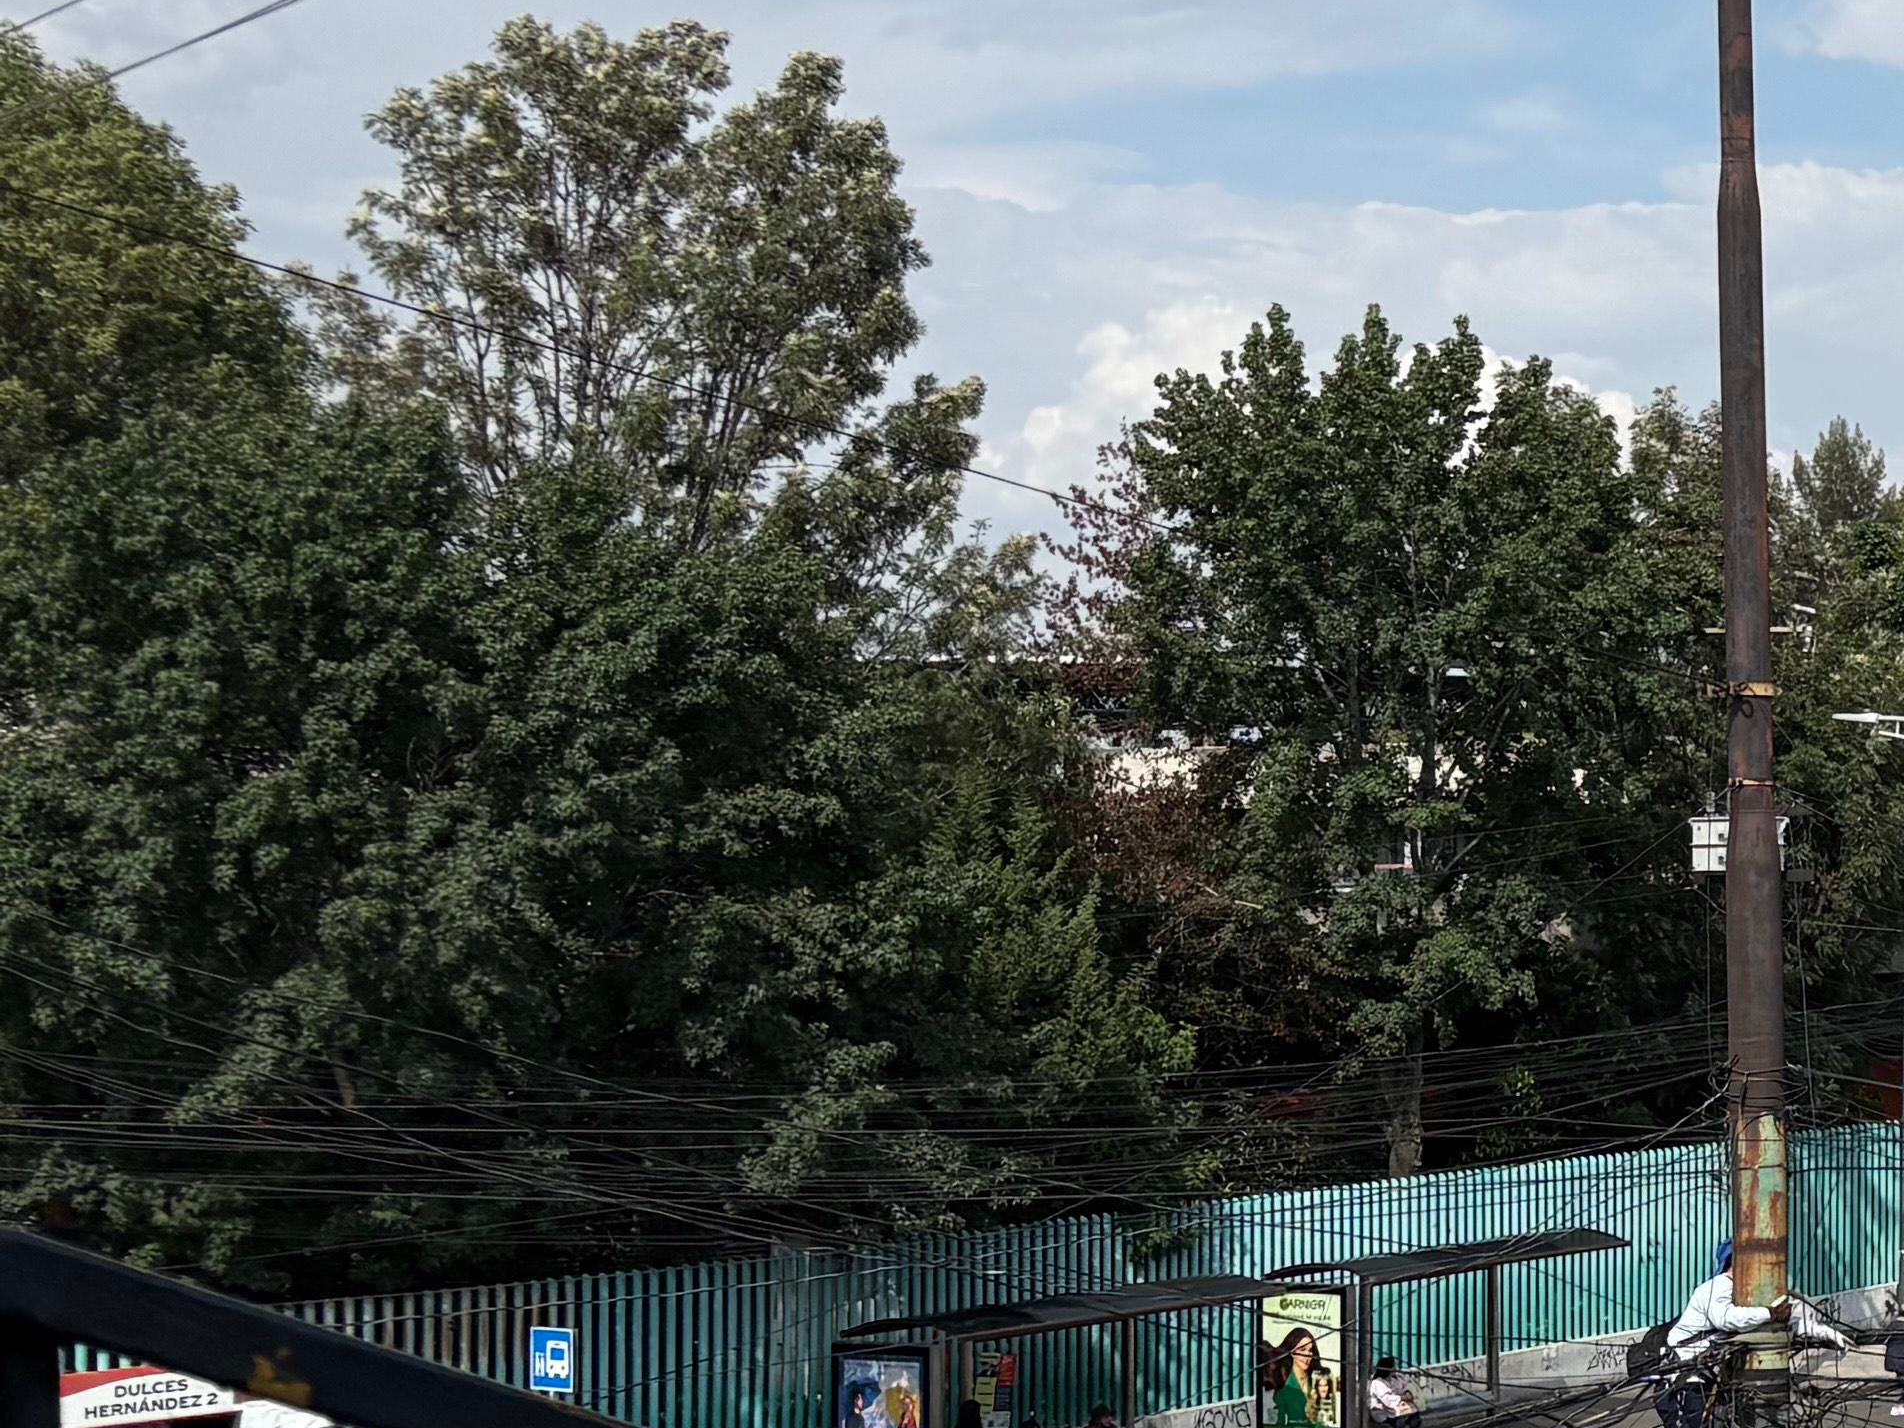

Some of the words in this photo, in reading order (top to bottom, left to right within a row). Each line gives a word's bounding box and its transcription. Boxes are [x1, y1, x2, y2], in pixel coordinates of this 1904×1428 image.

[1279, 1297, 1326, 1311] GARNIER
[114, 1378, 188, 1399] DULCES
[84, 1394, 202, 1420] HERNÁNDEZ
[206, 1392, 218, 1406] 2
